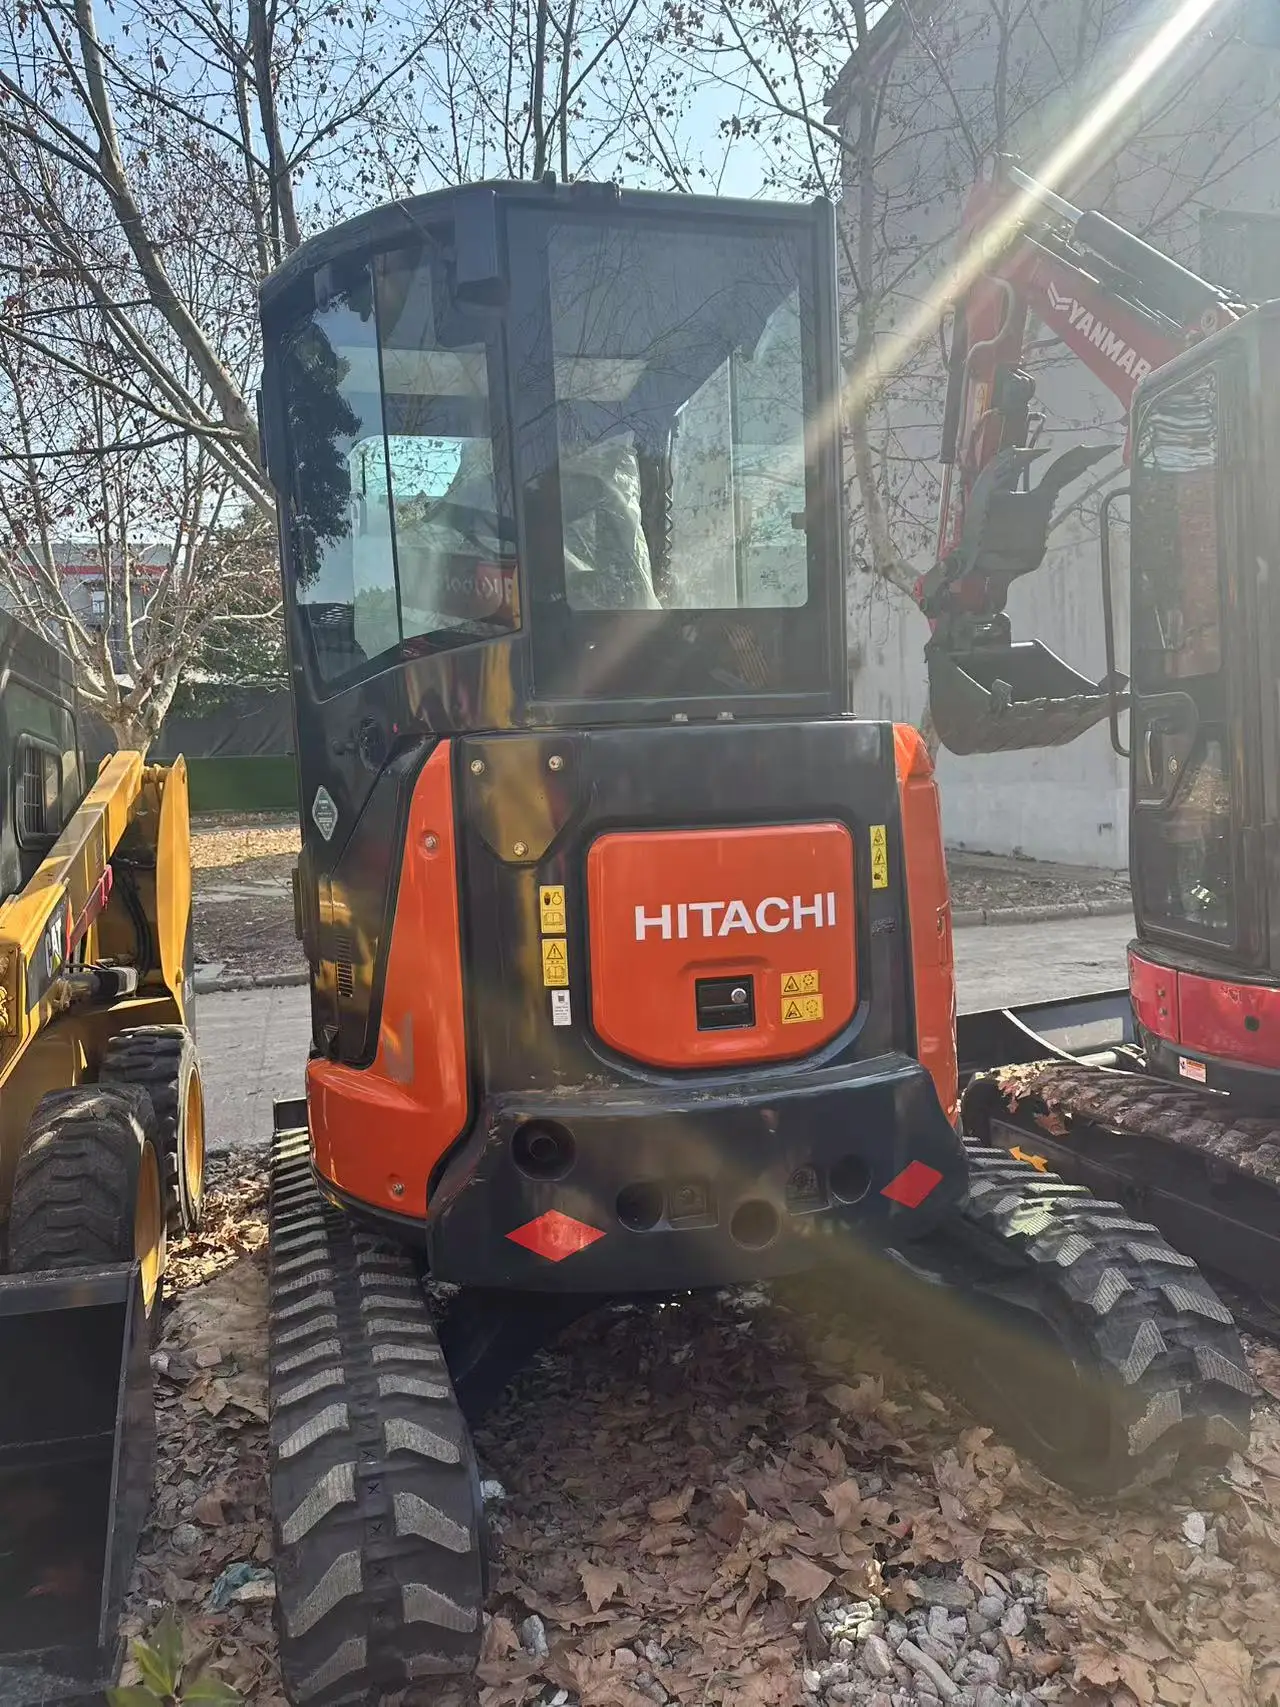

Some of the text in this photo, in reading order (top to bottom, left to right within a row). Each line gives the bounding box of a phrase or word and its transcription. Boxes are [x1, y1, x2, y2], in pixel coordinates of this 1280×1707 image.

[1068, 299, 1152, 381] YANMAR
[635, 892, 836, 940] HITACHI
[45, 917, 62, 978] CAT
